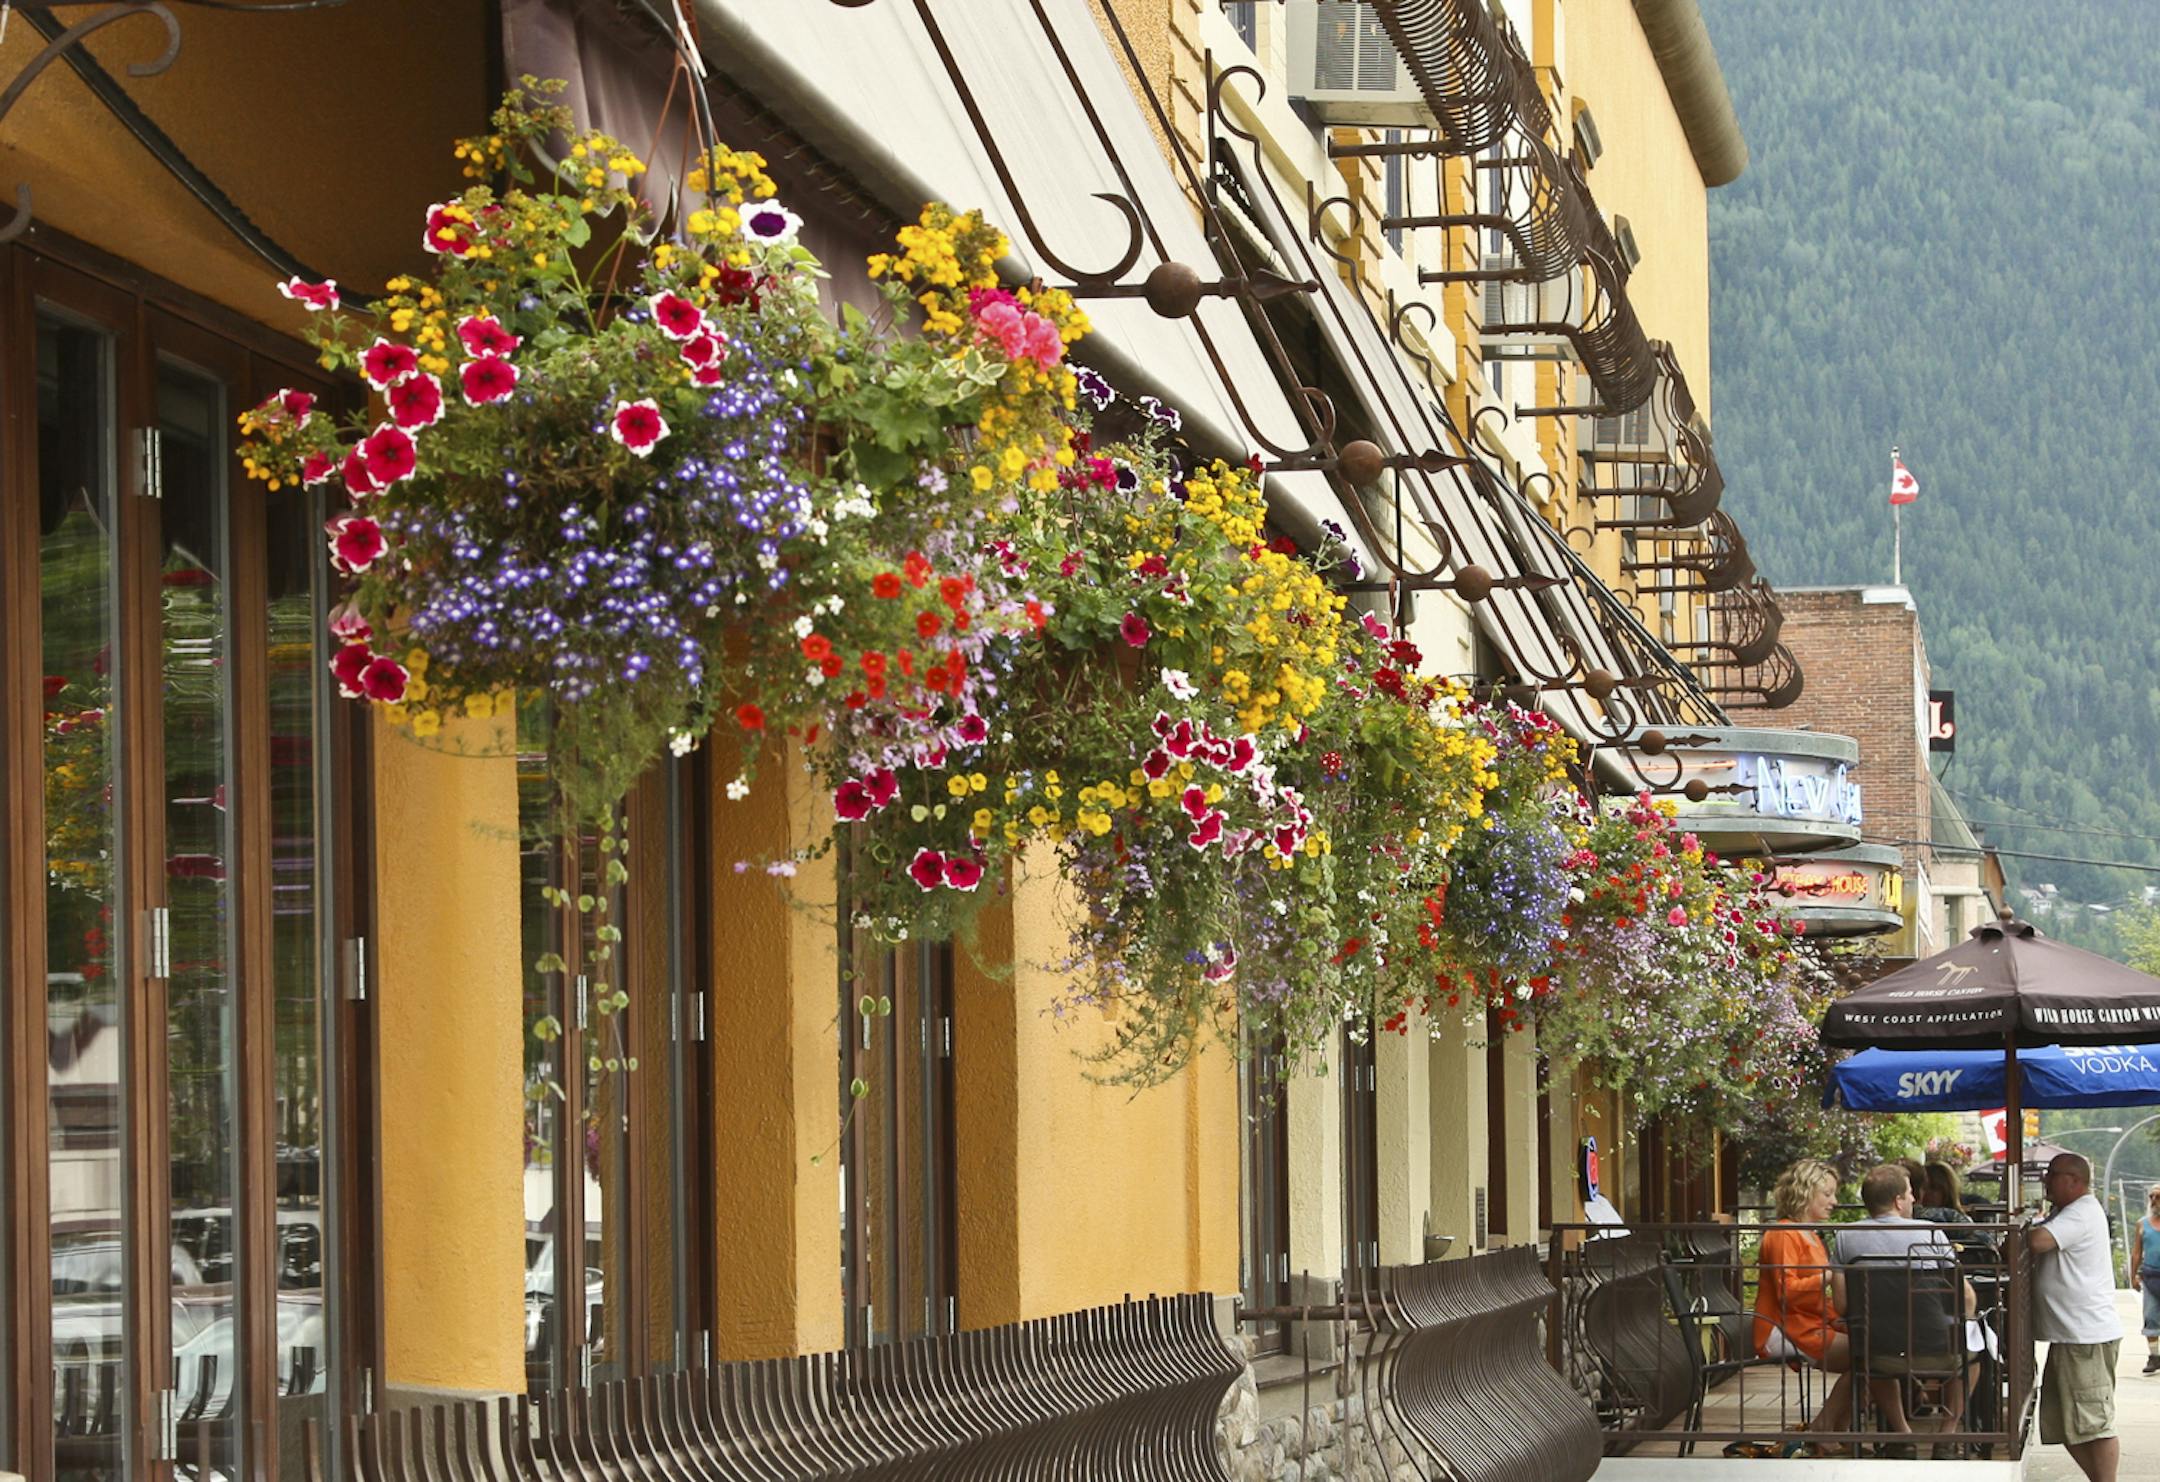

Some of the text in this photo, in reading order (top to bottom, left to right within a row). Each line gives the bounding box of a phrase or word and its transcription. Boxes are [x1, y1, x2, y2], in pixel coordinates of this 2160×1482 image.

[1830, 875, 1869, 894] HOUSE
[1844, 1009, 2003, 1024] WEST COAST APPELLATION
[2034, 1007, 2059, 1023] WILD
[2060, 1008, 2096, 1023] HORSE
[2098, 1007, 2141, 1023] CANYON
[2070, 1055, 2157, 1074] VODKA
[1897, 1069, 1962, 1098] SKYY
